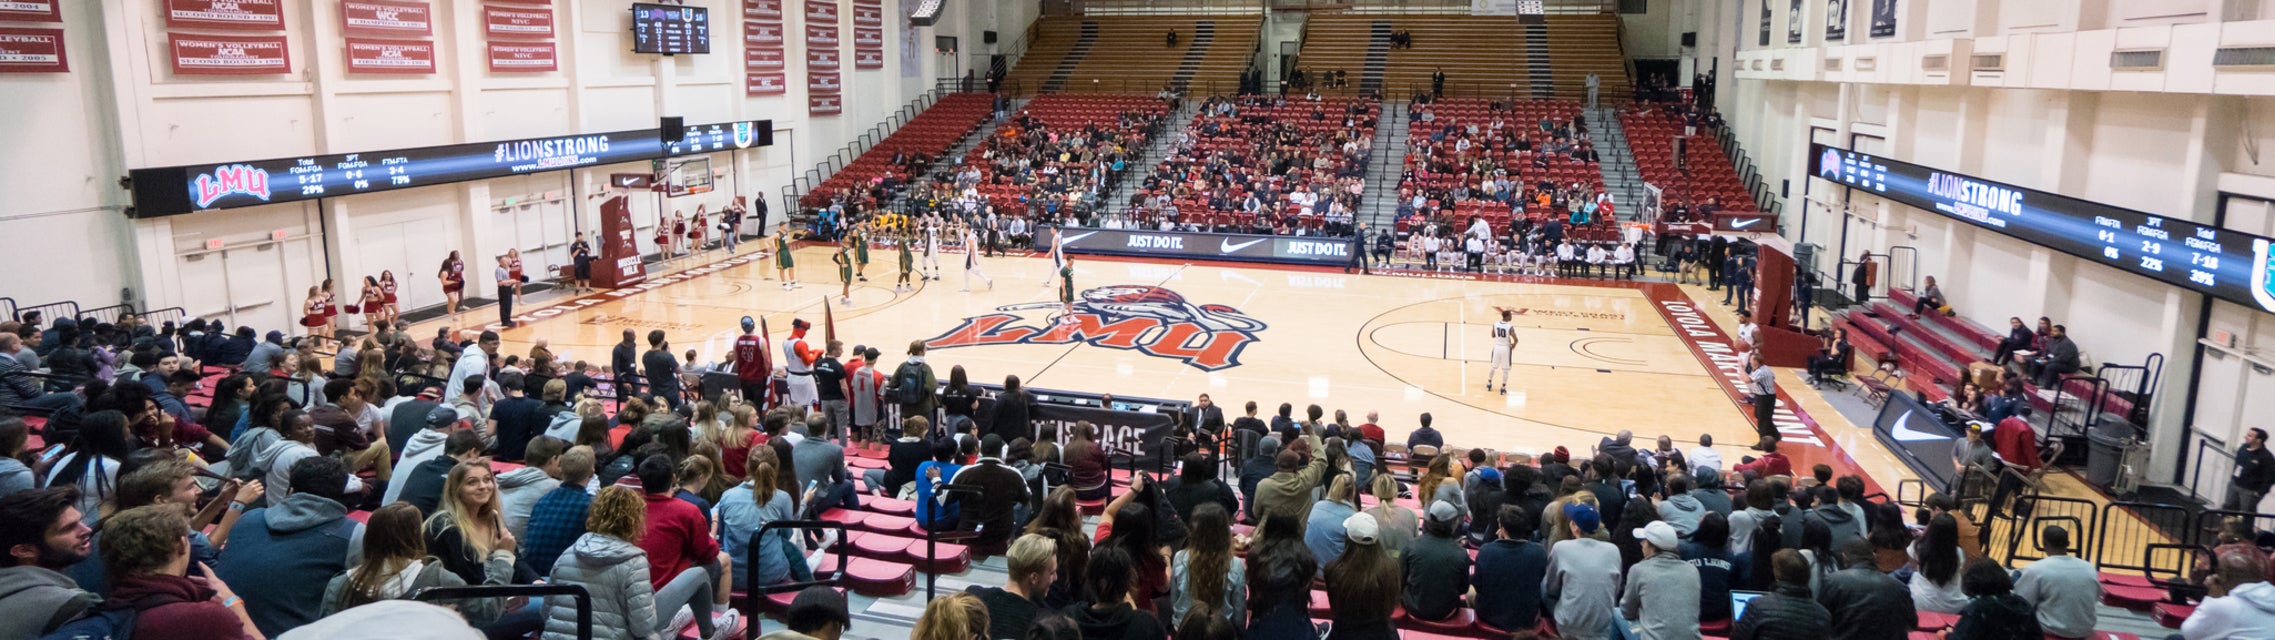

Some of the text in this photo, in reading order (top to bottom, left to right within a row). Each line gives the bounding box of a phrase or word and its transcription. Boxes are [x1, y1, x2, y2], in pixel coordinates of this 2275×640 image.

[375, 10, 399, 20] WCC
[179, 41, 224, 49] WOMEN'S
[494, 135, 610, 163] #LIONSTRONG
[297, 158, 315, 166] Total
[346, 154, 359, 162] 3PT
[298, 173, 323, 184] 5-17
[354, 179, 369, 189] 0%
[391, 174, 410, 185] 75%
[195, 164, 271, 208] LMU
[302, 184, 325, 195] 29%
[1927, 172, 2023, 216] #LIONSTRONG
[2196, 227, 2216, 240] Total
[1127, 235, 1184, 249] JUST DO IT.
[1287, 241, 1347, 256] JUST DO IT.
[2141, 240, 2161, 254] 2-9
[617, 255, 642, 269] MUSCLE
[2140, 255, 2164, 272] 22%
[2191, 252, 2219, 270] 7-18
[622, 265, 639, 277] MILK
[1660, 299, 1719, 337] LOYOLA
[1496, 327, 1507, 338] 10
[924, 313, 1262, 373] LMU
[1703, 557, 1732, 571] LIONS
